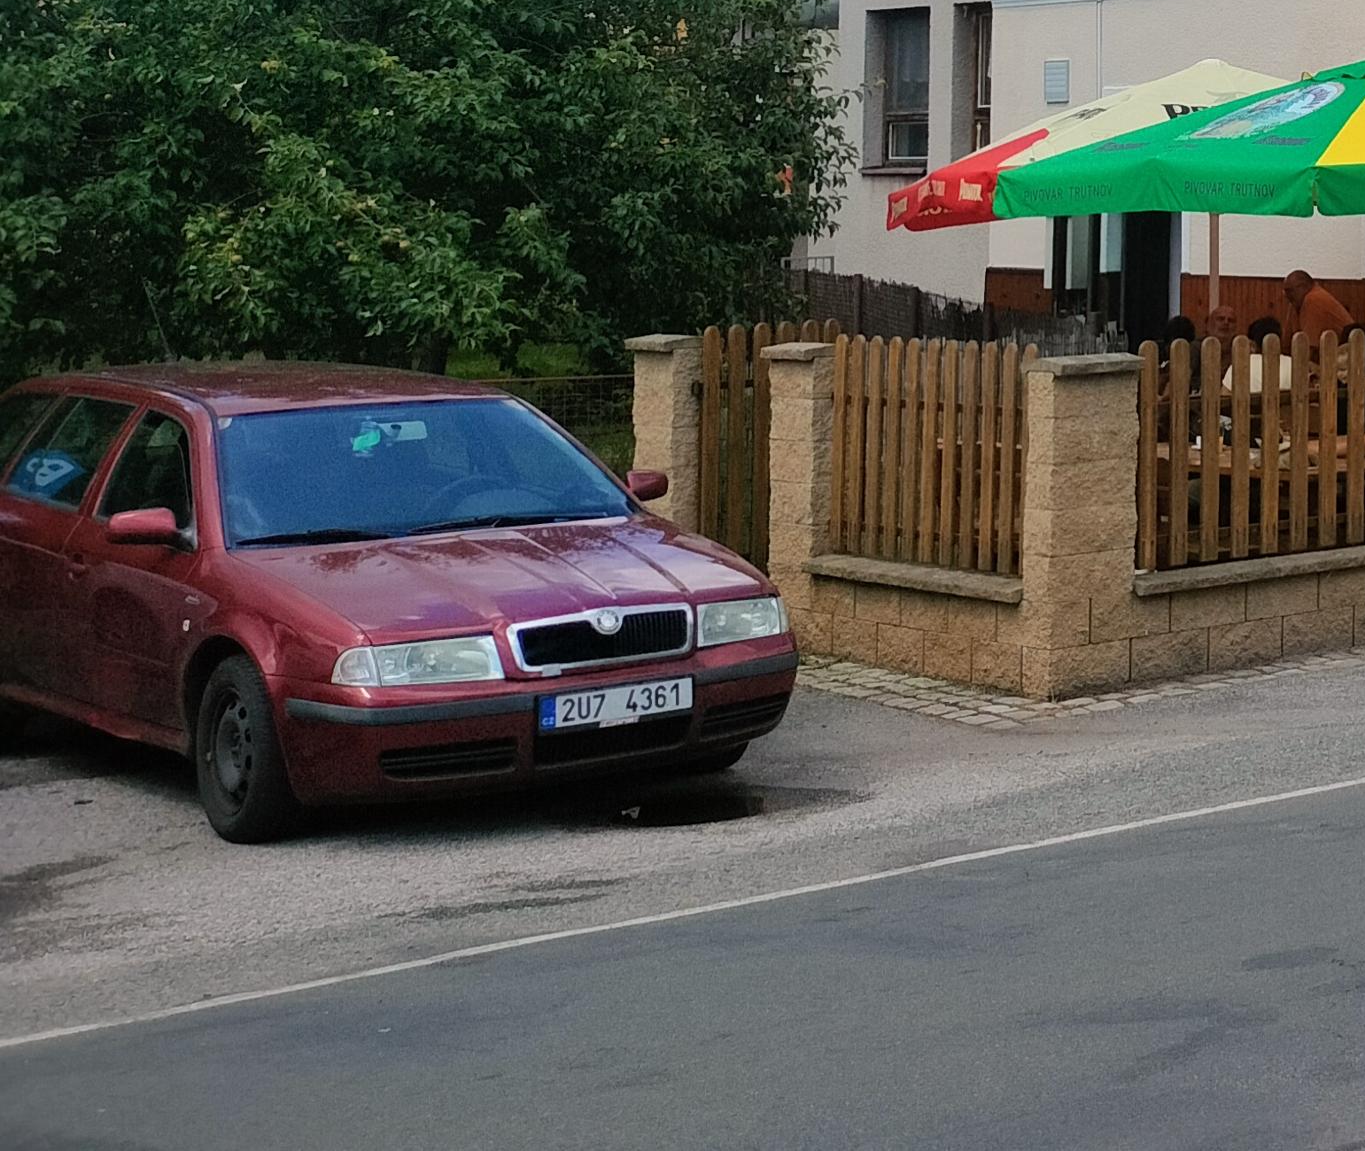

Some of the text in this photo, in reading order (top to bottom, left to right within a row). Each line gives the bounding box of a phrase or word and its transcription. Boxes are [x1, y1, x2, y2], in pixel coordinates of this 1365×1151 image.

[1023, 184, 1114, 202] PIVOVAR TRUTNOV
[1184, 180, 1277, 199] PIVOVAR TRUTNOV
[562, 682, 680, 723] 2U7 4361
[541, 716, 555, 727] CZ
